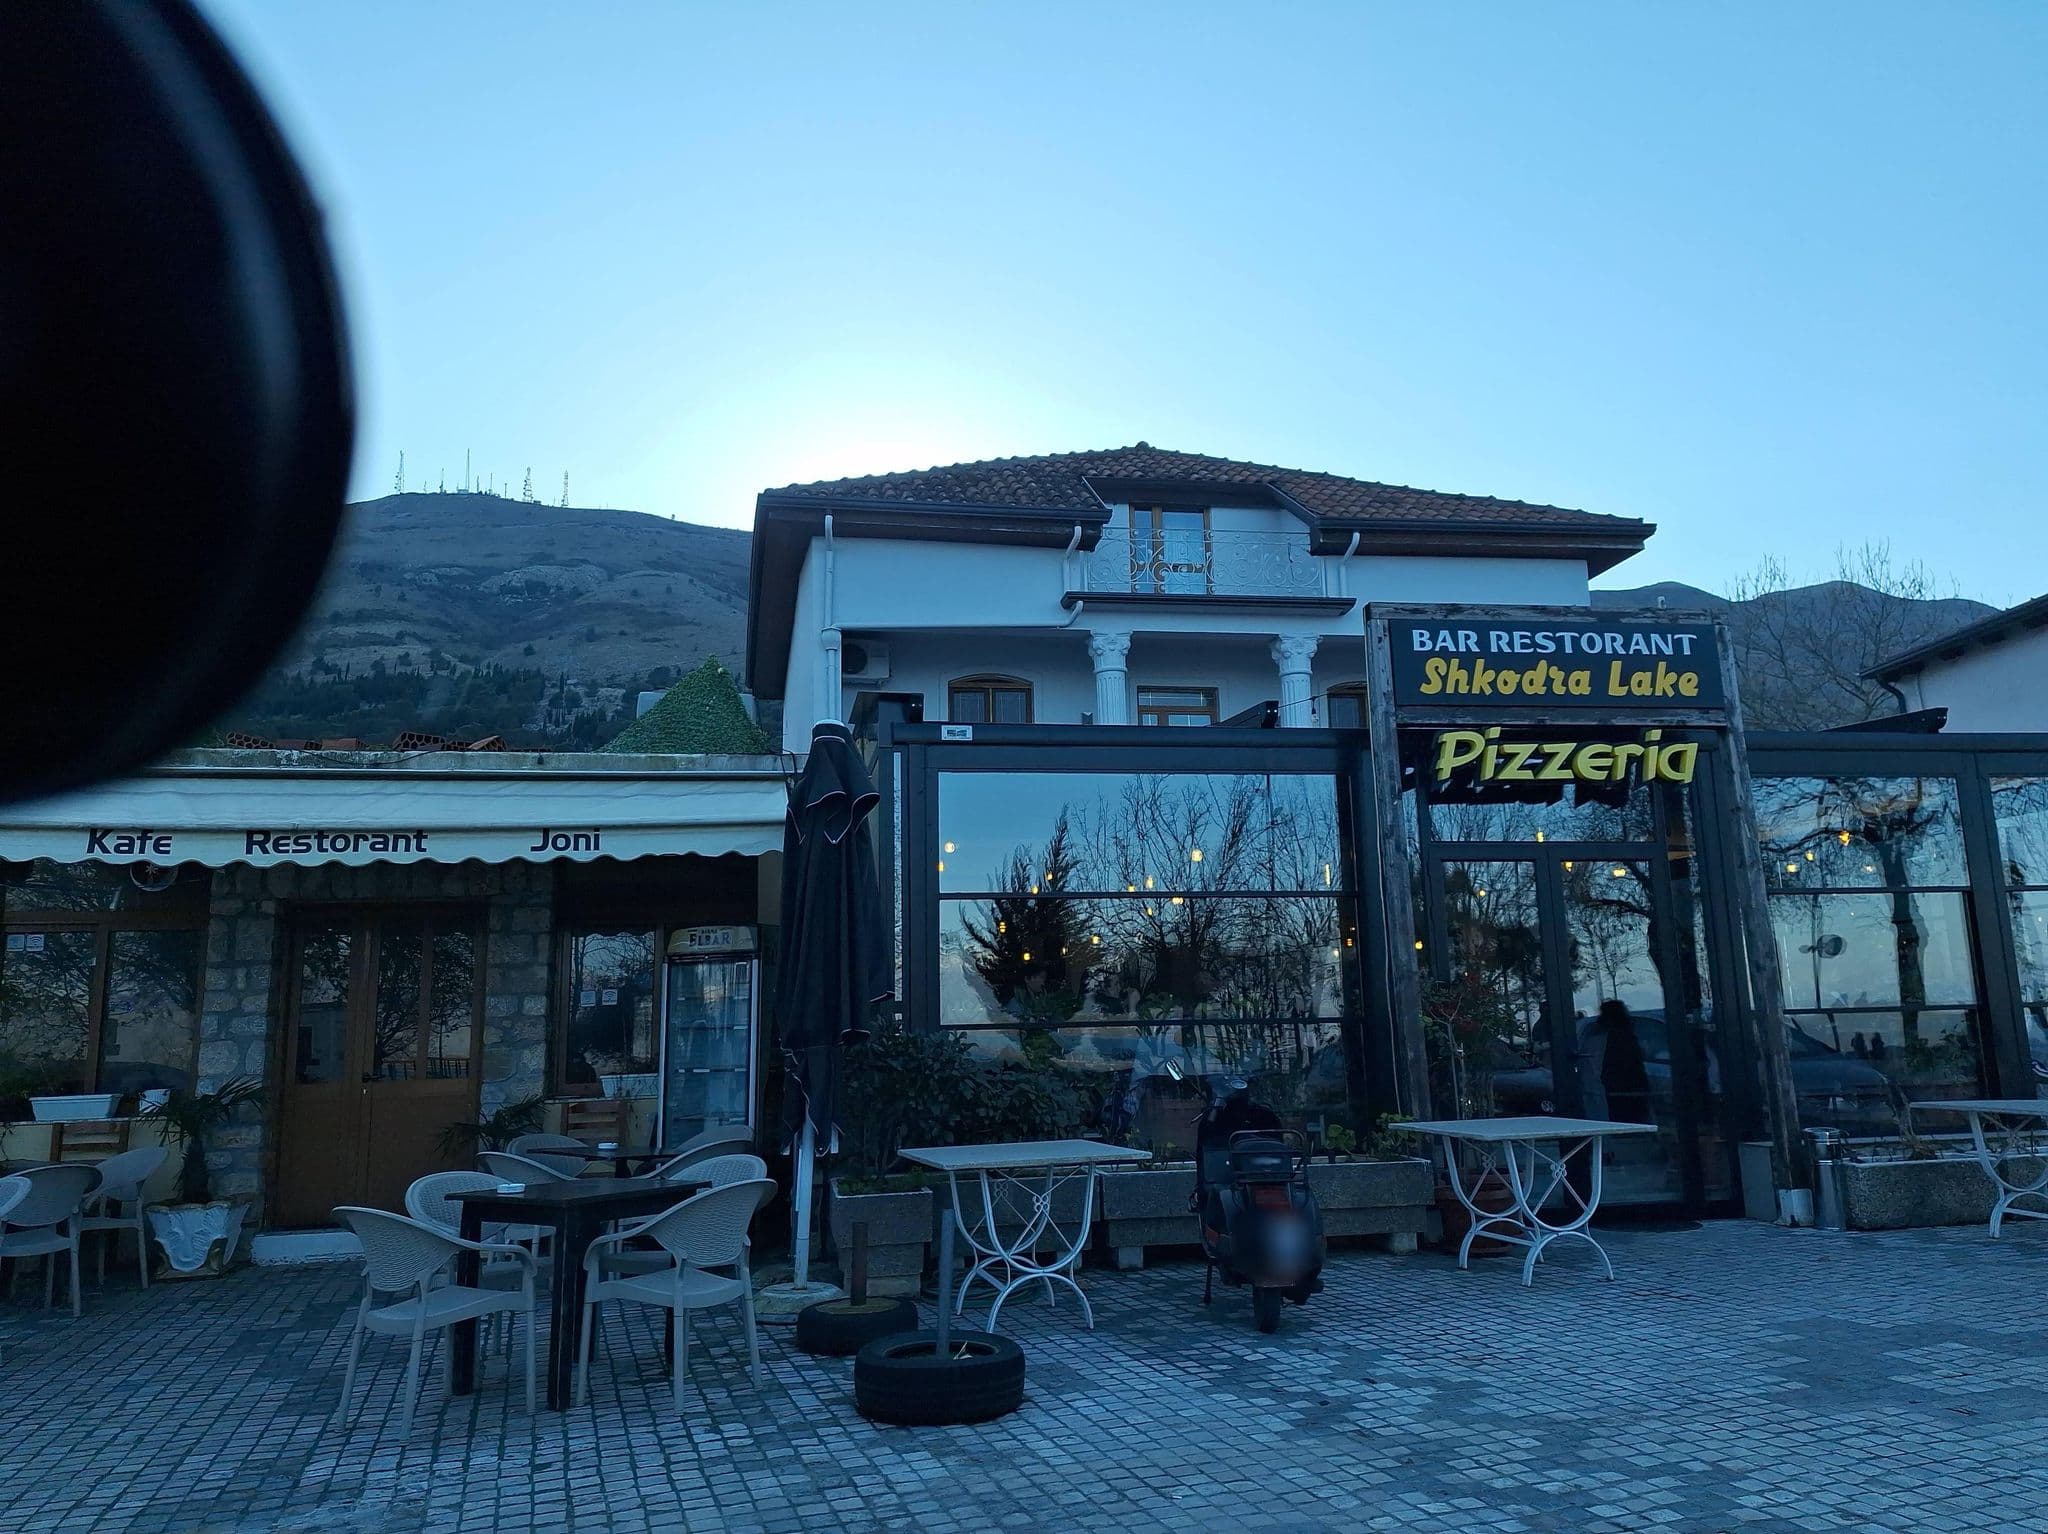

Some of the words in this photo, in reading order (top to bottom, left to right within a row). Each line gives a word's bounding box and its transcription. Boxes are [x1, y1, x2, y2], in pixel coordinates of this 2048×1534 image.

[1412, 629, 1480, 652] BAR
[1490, 632, 1698, 656] RESTORANT
[1420, 657, 1592, 696] Shkodra
[1608, 660, 1699, 698] Lake
[1436, 726, 1699, 784] Pizzeria
[86, 828, 173, 855] Kafe
[245, 829, 428, 855] Restorant
[530, 827, 601, 852] Joni
